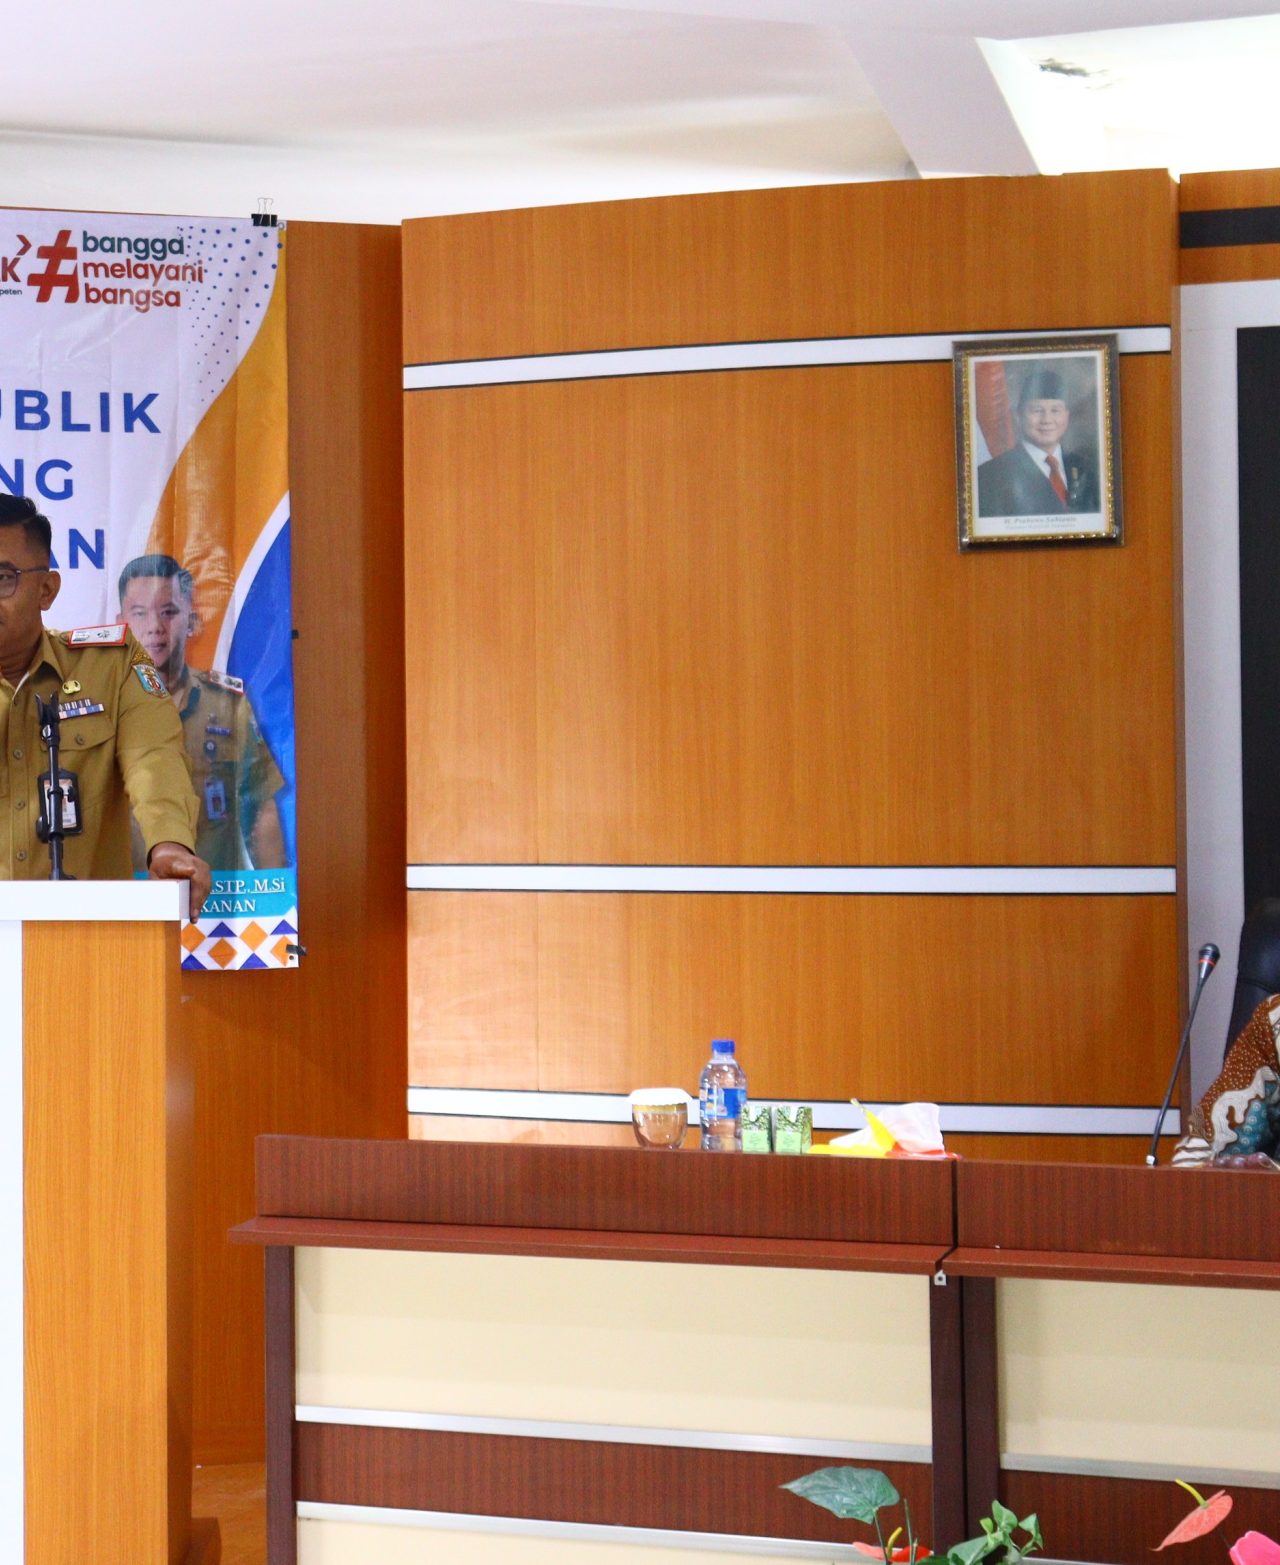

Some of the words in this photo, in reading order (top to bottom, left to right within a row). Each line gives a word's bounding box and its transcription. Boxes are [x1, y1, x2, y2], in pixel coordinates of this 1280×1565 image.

[82, 230, 184, 261] bangga
[83, 258, 203, 287] melayani
[84, 283, 181, 313] bangsa
[254, 877, 286, 894] M.Si
